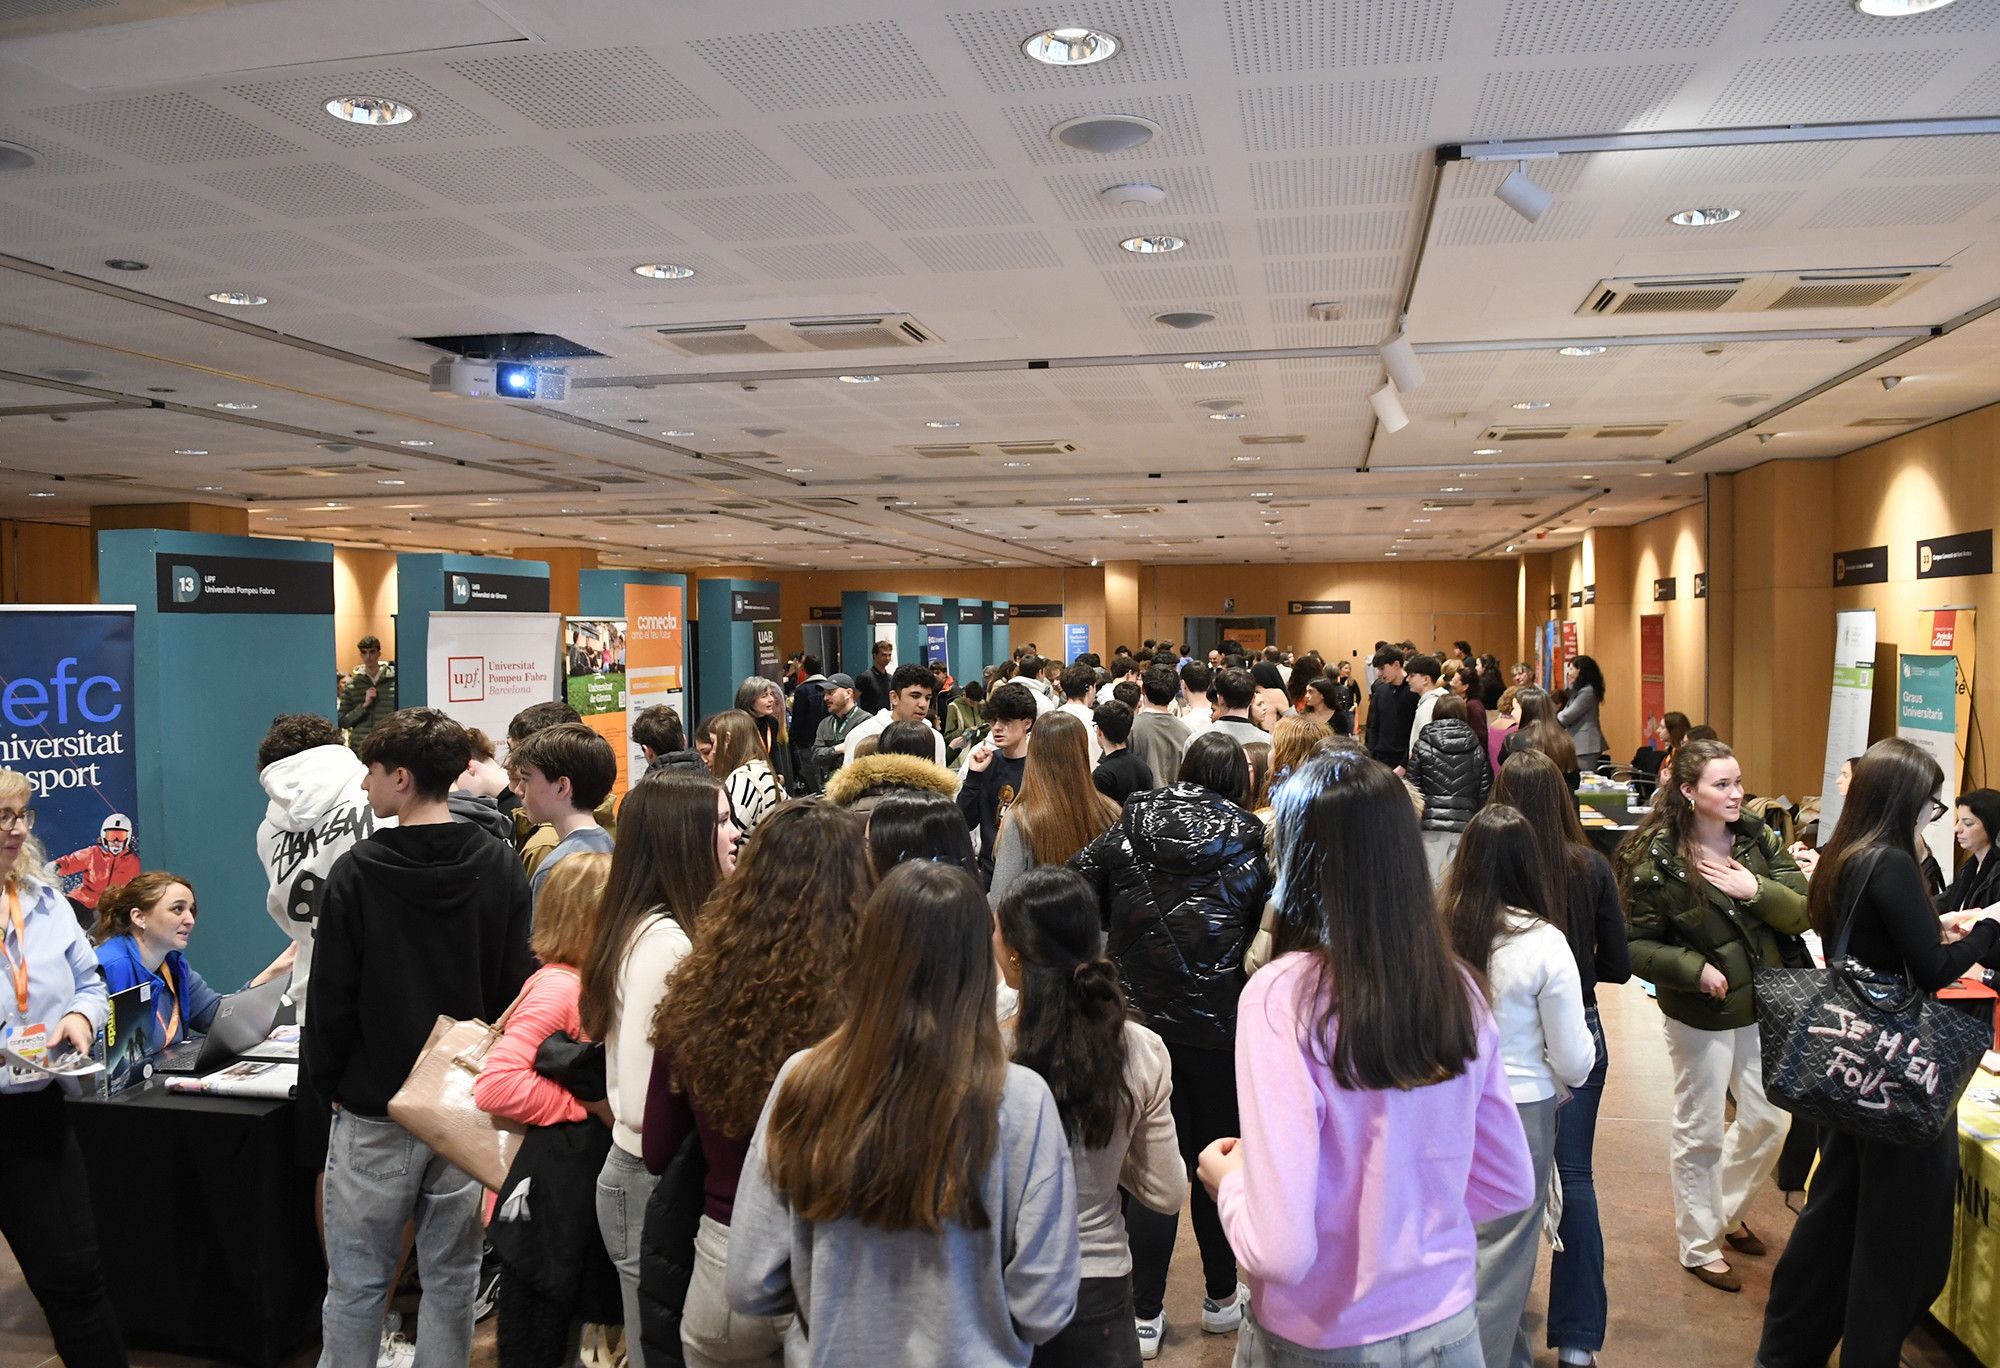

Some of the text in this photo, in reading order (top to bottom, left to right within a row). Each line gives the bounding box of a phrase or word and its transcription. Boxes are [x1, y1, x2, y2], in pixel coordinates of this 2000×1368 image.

[179, 577, 194, 592] 13
[204, 586, 275, 596] Universitat Pompeu Fabra
[457, 585, 466, 596] 14
[637, 611, 677, 630] connecta
[758, 631, 774, 644] UAB
[488, 661, 535, 670] Universitat
[489, 672, 547, 684] Pompeu Fabra
[0, 657, 122, 726] efc
[489, 685, 532, 695] Barcelona
[1903, 691, 1923, 704] Graus
[1903, 706, 1944, 720] Universitaris
